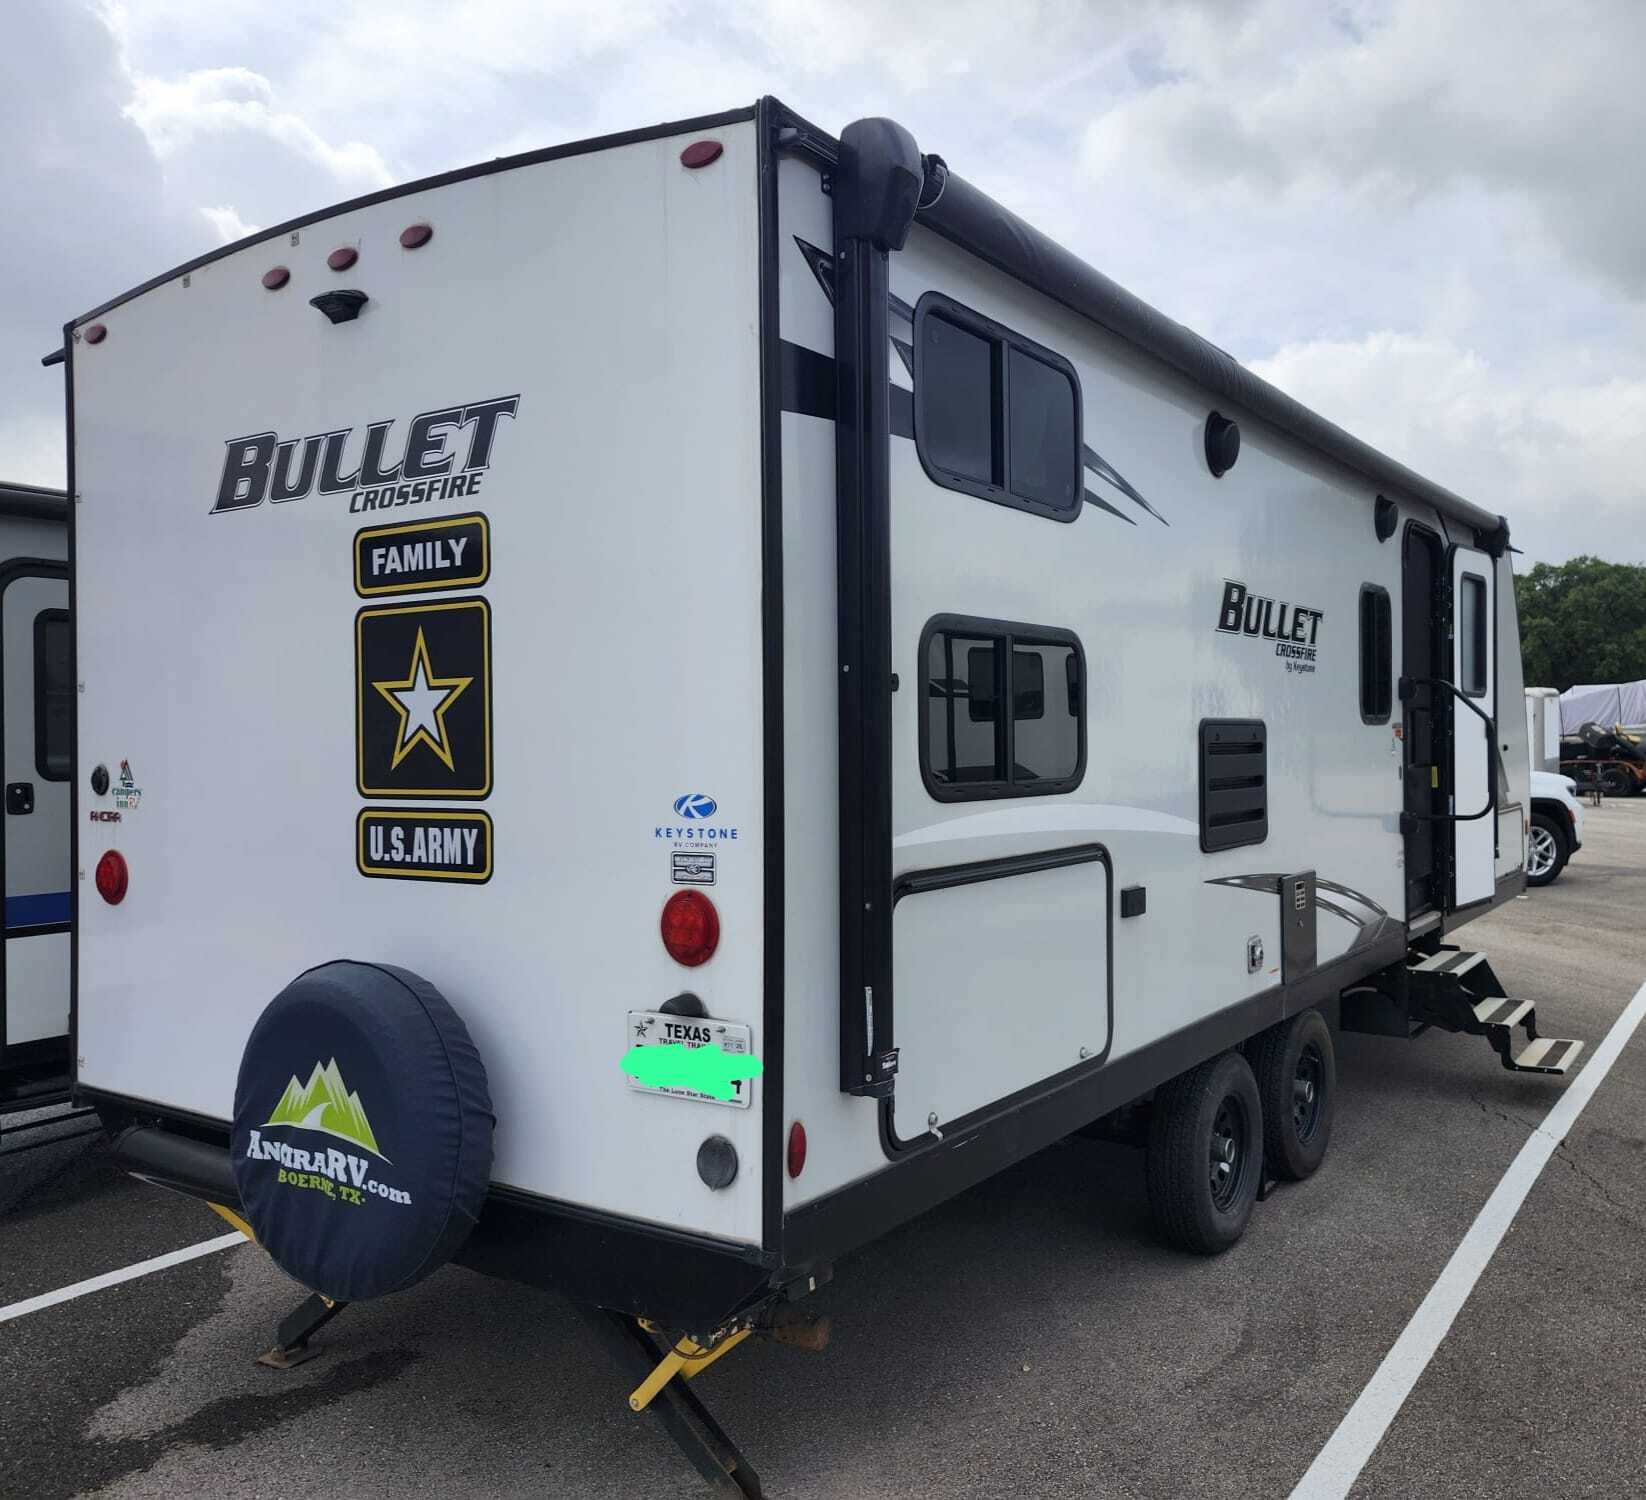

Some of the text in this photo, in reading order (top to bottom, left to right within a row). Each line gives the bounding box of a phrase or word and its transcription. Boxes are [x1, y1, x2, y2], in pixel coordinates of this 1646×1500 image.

[208, 393, 521, 515] BULLET
[349, 472, 485, 514] CROSSFIRE
[372, 537, 468, 576] FAMILY
[1215, 577, 1324, 648] BULLET
[1276, 643, 1317, 661] CROSSFIRE
[655, 827, 738, 840] KEYSTONE
[665, 1023, 711, 1043] TEXAS
